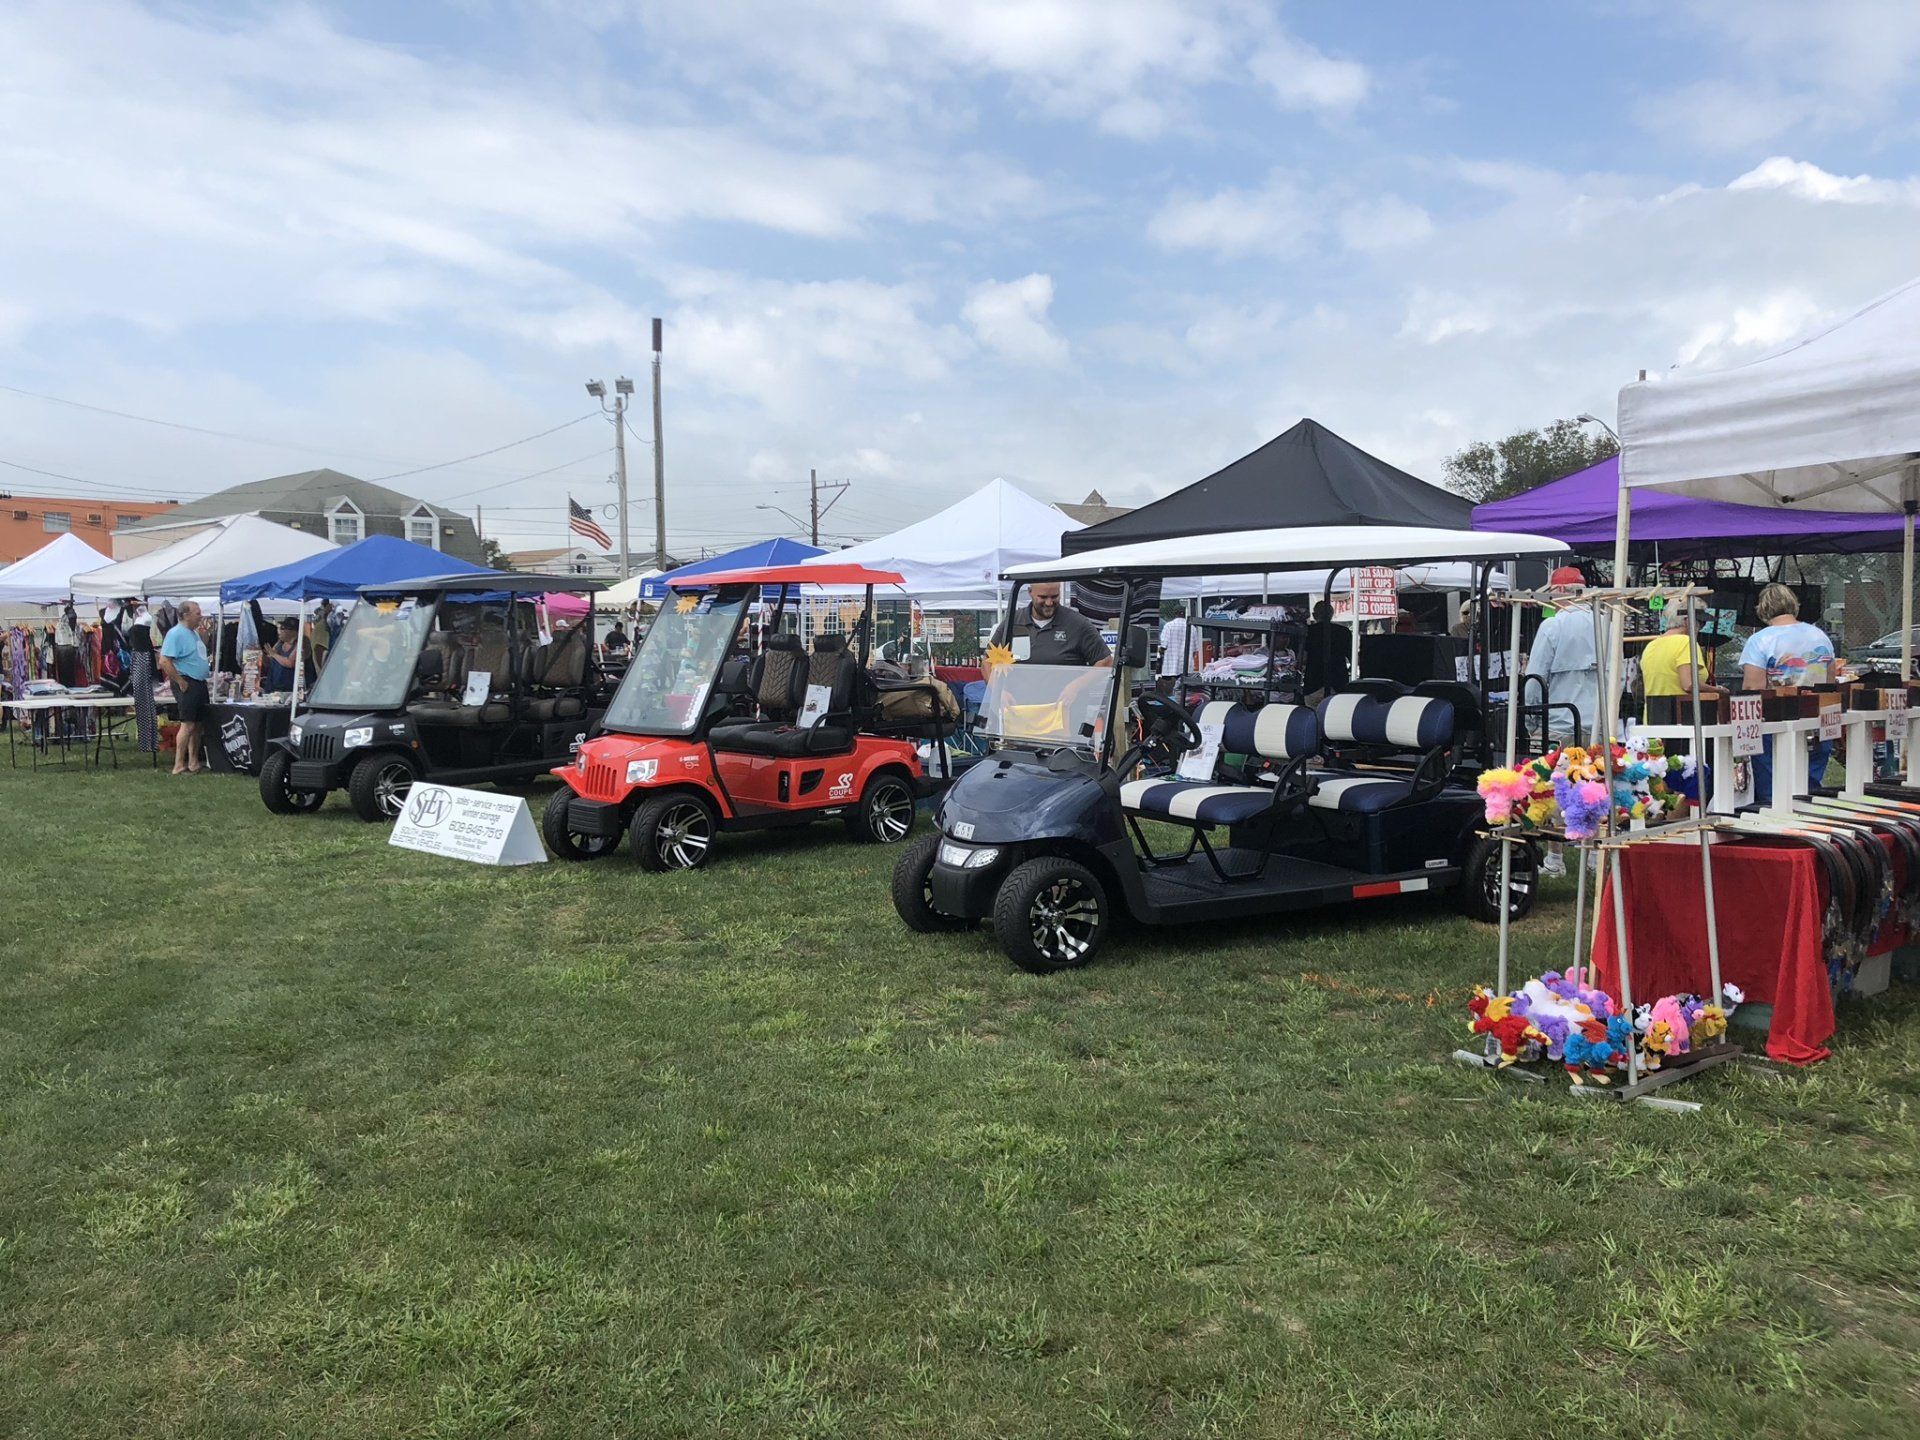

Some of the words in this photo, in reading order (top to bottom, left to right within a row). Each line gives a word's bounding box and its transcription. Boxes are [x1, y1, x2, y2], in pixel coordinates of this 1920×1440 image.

[1372, 568, 1393, 578] SALAD
[1374, 578, 1392, 588] CUPS
[1370, 602, 1396, 615] COFFEE
[1886, 693, 1907, 710] BELTS
[1731, 700, 1761, 720] BELTS
[1736, 725, 1742, 739] 2
[1747, 724, 1760, 739] $22
[829, 788, 853, 797] COUPE
[417, 839, 442, 850] VEHICLES
